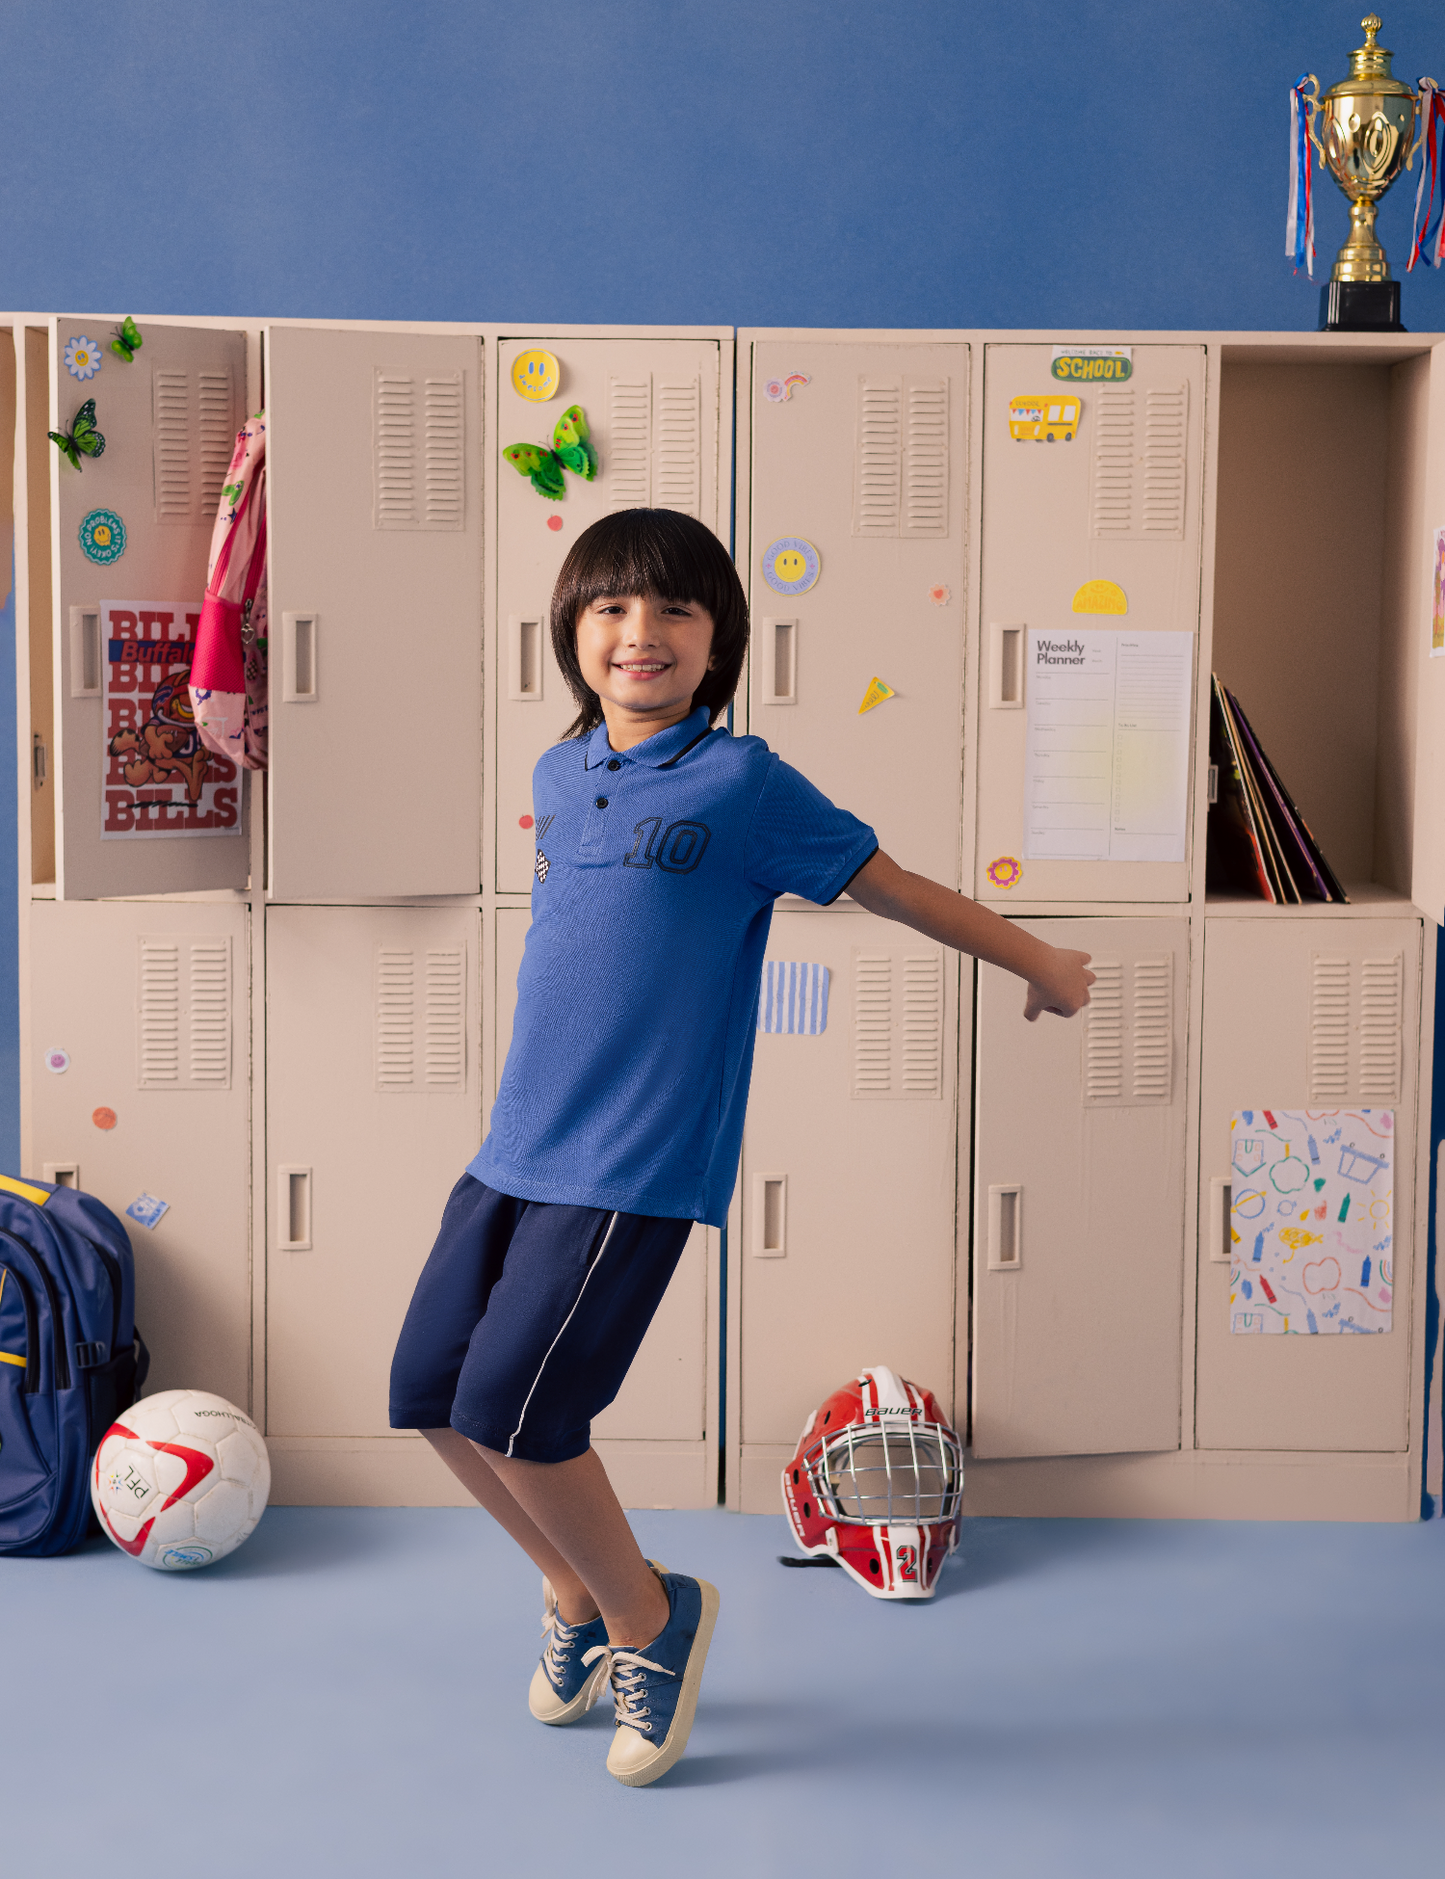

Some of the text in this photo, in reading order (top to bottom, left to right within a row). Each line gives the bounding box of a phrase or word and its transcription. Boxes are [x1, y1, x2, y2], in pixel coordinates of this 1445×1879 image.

[1056, 356, 1125, 379] SCHOOL
[86, 515, 121, 534] PROBLEMS
[84, 532, 92, 545] NO
[767, 540, 790, 561] GOOD
[767, 571, 790, 592] GOOD
[1037, 639, 1085, 656] Weekly
[1036, 652, 1086, 665] Planner
[104, 787, 238, 832] BILLS
[623, 816, 712, 875] 10
[124, 1465, 150, 1500] PFL
[896, 1545, 918, 1583] 2
